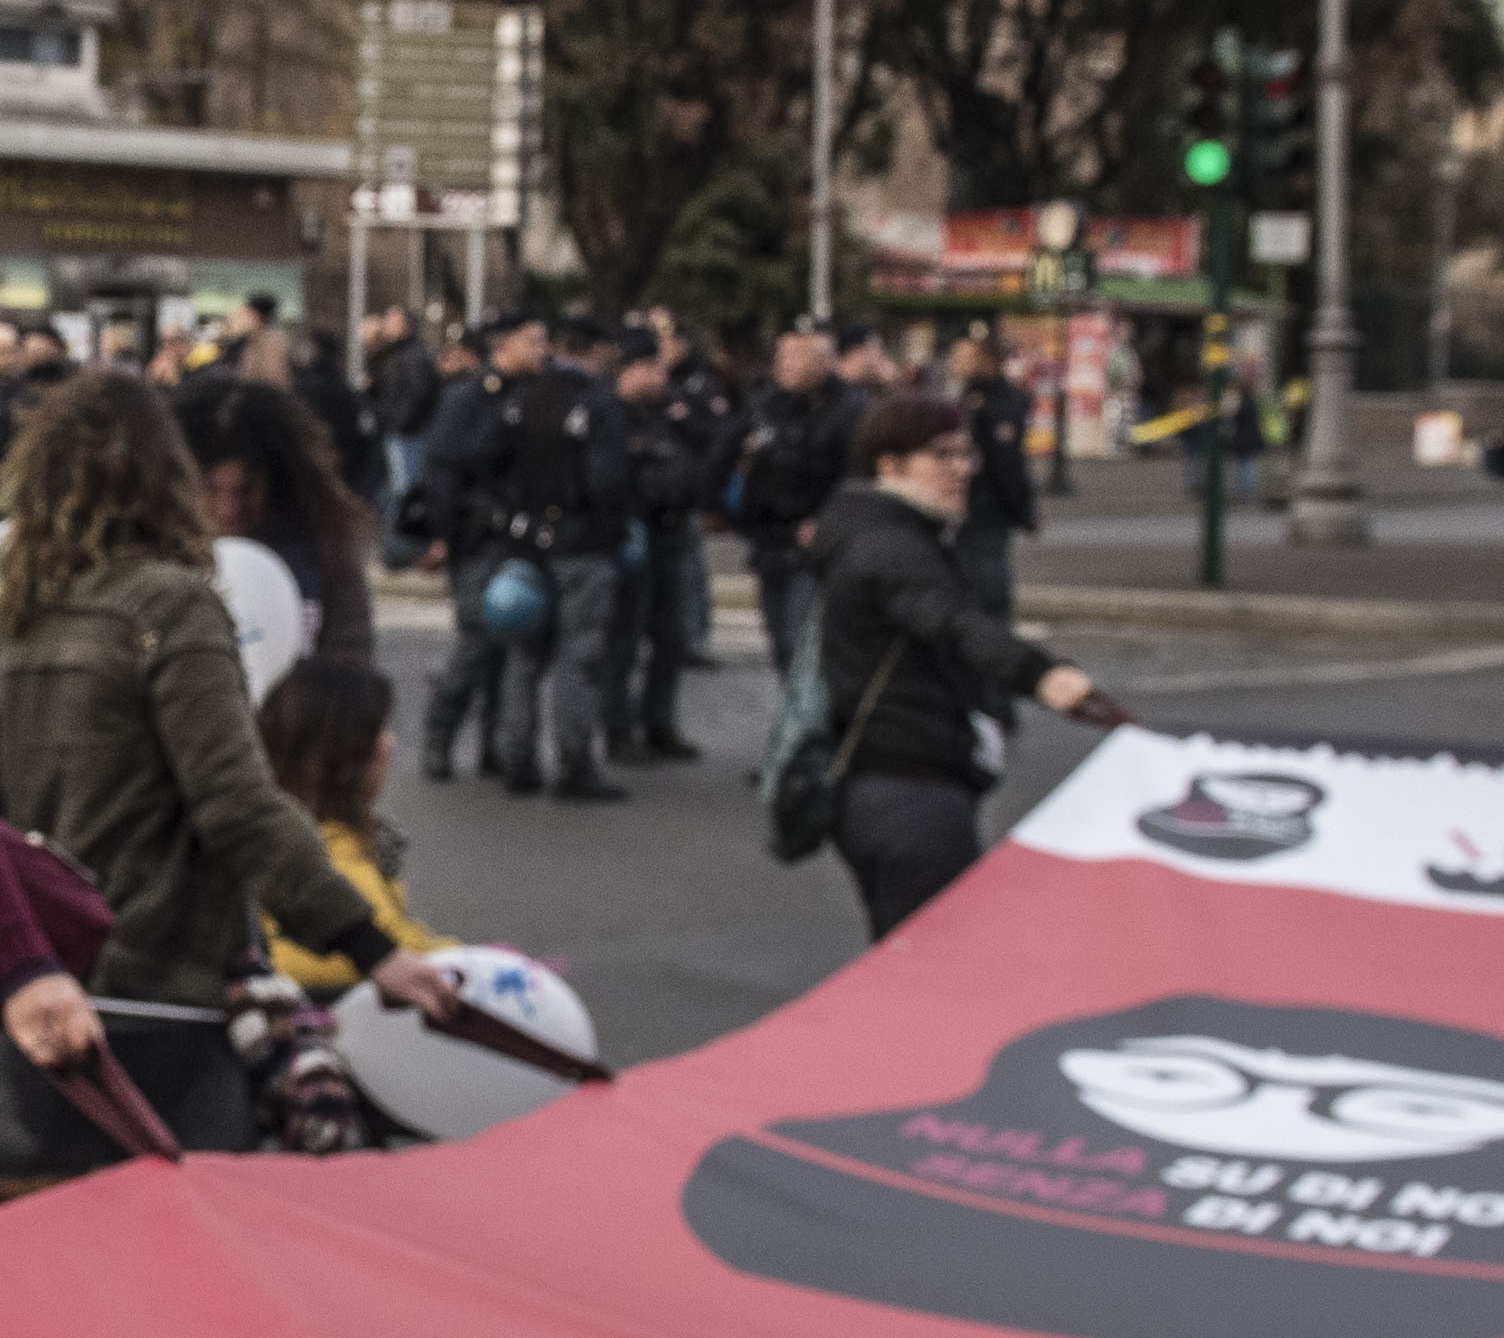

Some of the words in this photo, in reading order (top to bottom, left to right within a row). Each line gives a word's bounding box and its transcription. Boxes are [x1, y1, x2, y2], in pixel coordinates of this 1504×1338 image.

[898, 1112, 1150, 1177] NULLA
[1158, 1157, 1281, 1199] SU
[1285, 1169, 1380, 1213] DI
[1180, 1196, 1281, 1238] DI
[1286, 1205, 1453, 1259] NOI
